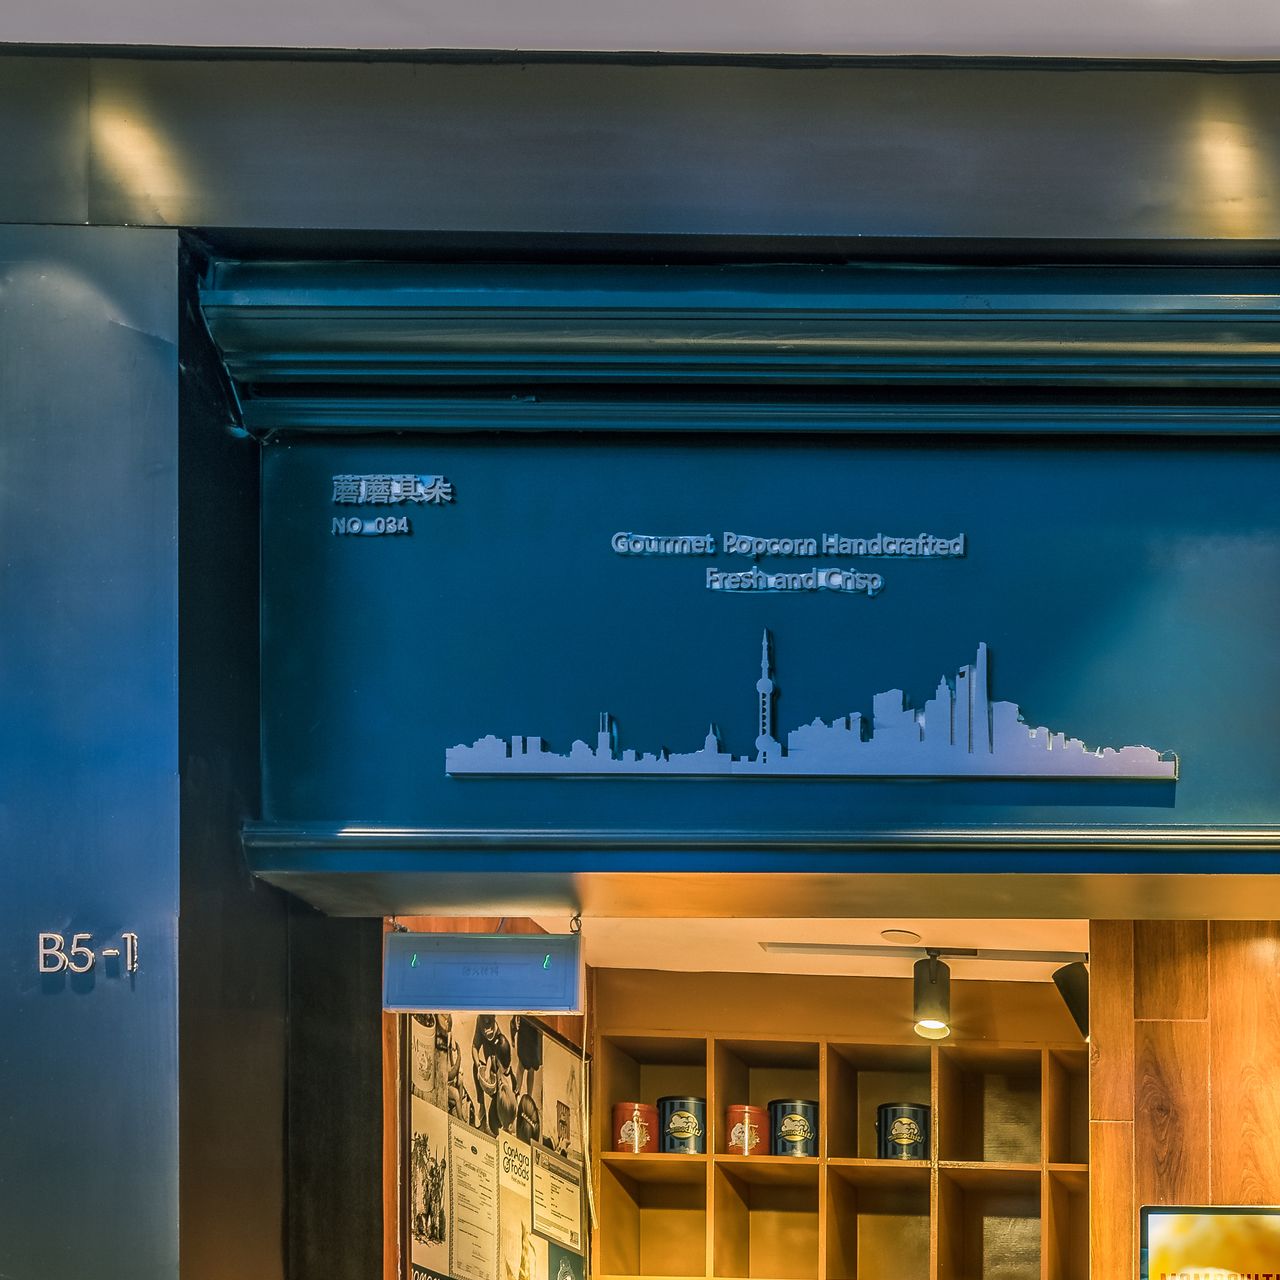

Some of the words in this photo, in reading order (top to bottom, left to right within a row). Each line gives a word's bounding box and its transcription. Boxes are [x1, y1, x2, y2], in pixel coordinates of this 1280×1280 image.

[332, 474, 453, 503] 蘑蘑其朵
[375, 516, 409, 534] 034
[611, 531, 714, 554] Gourmet
[723, 532, 817, 559] Popcorn
[822, 533, 965, 556] Handcrafted
[706, 566, 769, 590] Fresh
[774, 567, 818, 590] and
[824, 567, 882, 597] Crisp
[503, 1141, 530, 1167] ConAgra
